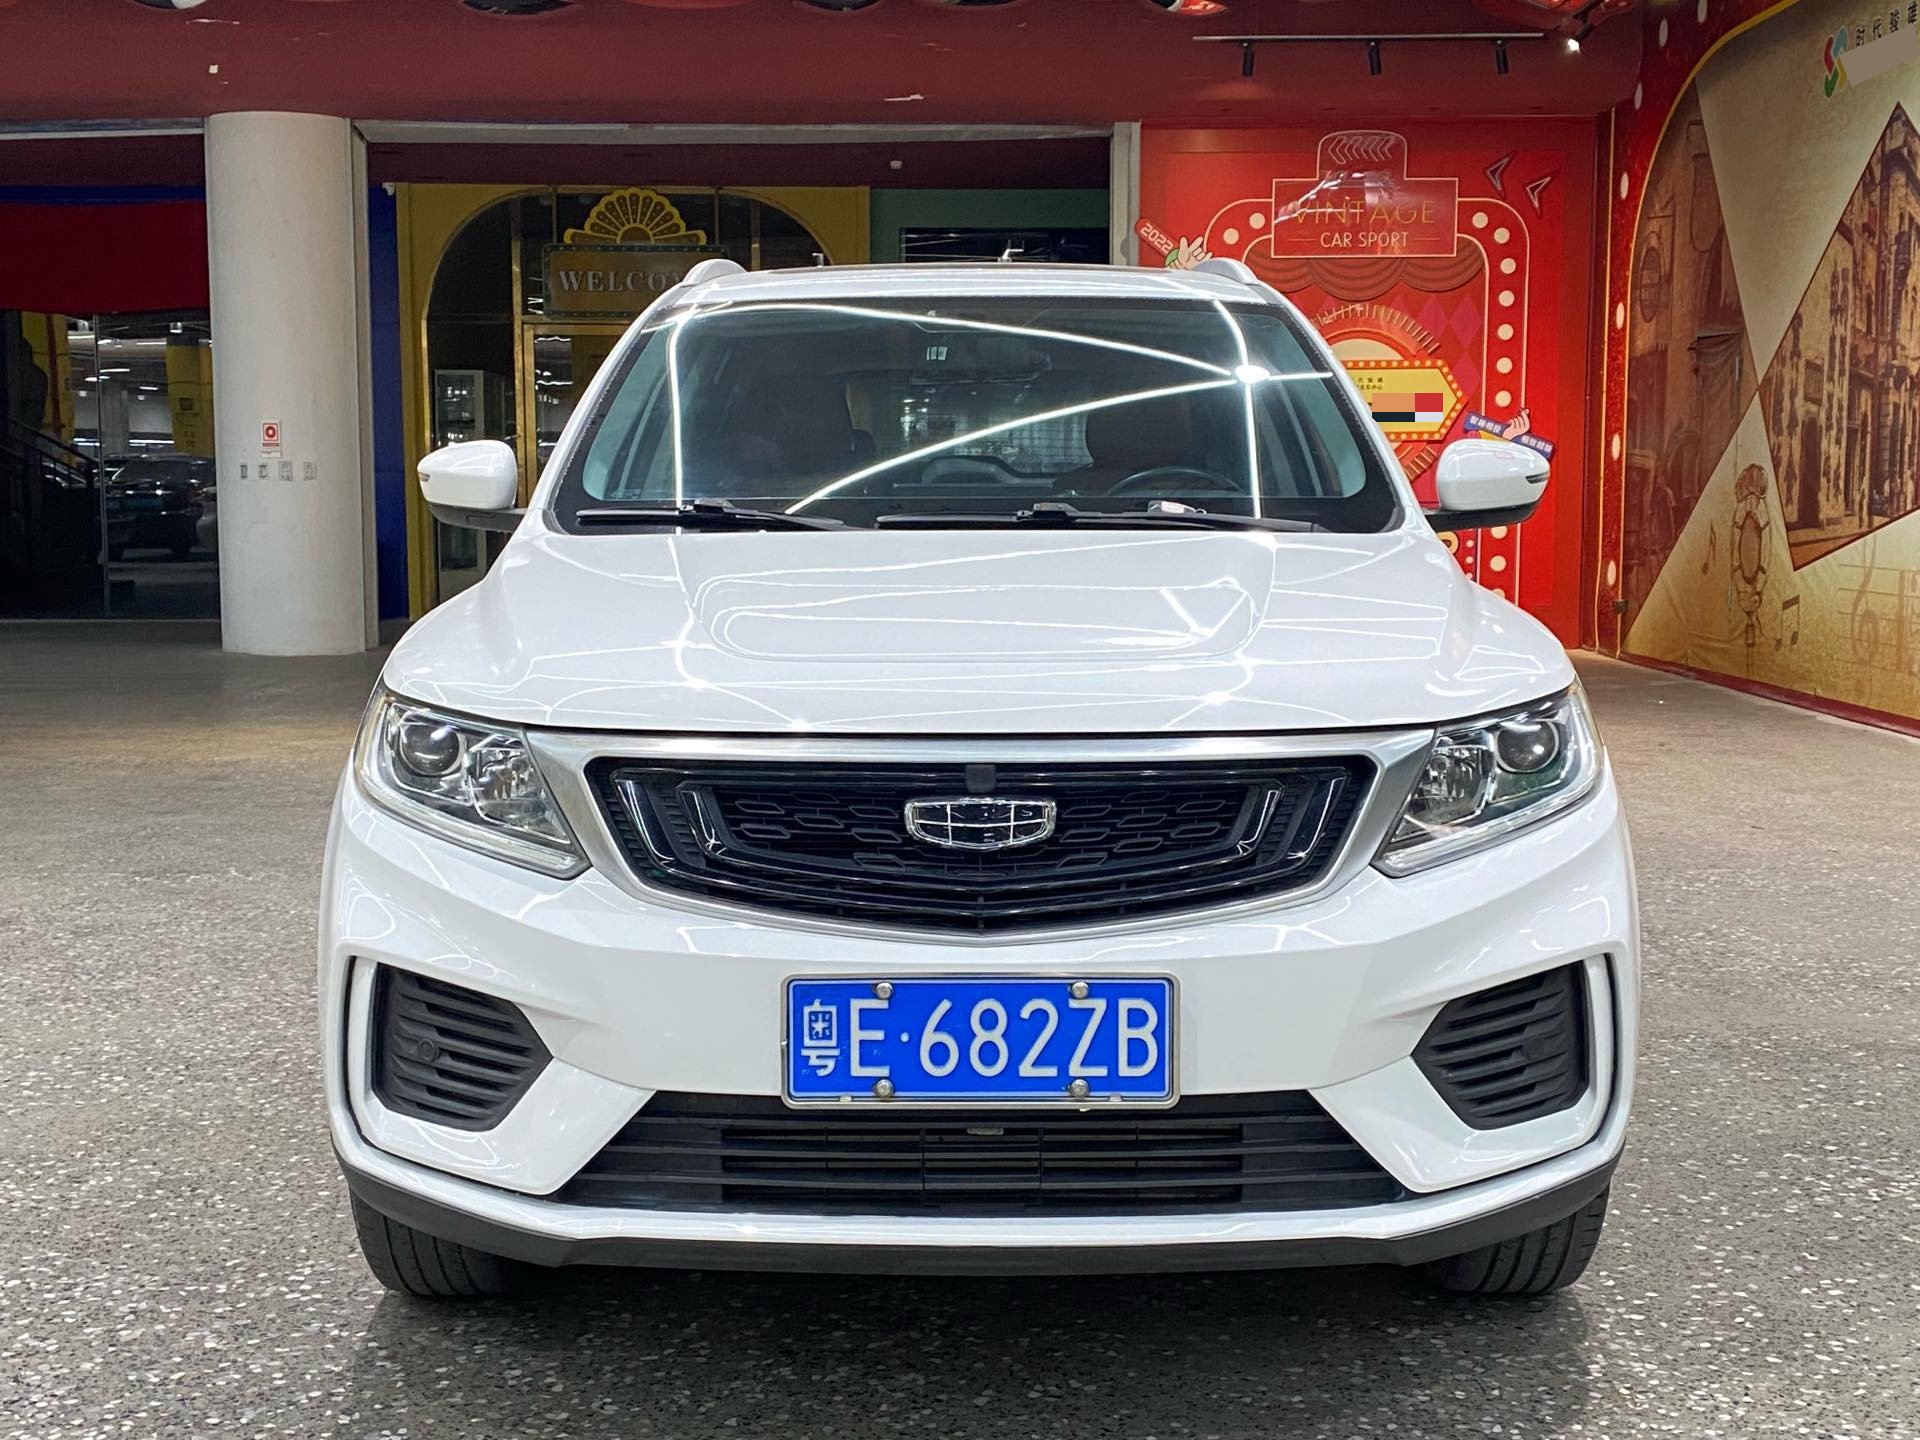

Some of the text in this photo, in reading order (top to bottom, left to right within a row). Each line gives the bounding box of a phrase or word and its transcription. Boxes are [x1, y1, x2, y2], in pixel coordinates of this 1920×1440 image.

[1295, 200, 1436, 225] VINTAGE
[1140, 222, 1174, 256] 2022
[1320, 231, 1409, 248] CAR SPORT
